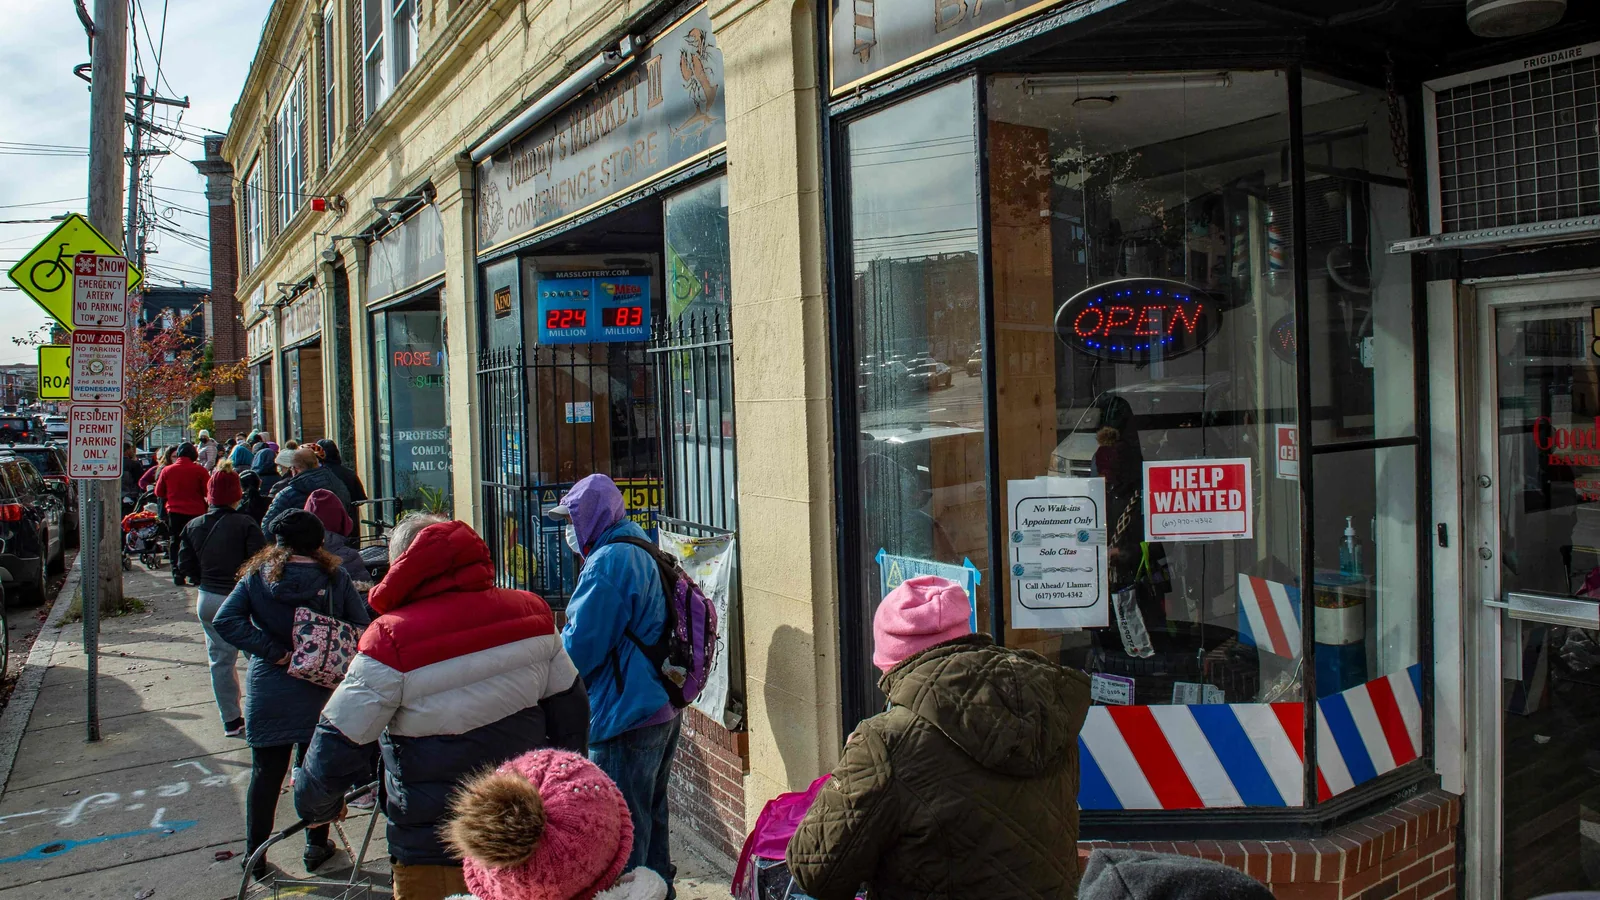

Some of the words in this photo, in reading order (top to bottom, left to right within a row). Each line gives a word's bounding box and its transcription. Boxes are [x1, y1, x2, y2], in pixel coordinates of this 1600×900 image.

[1523, 47, 1582, 69] FRIGIDAIRE
[569, 70, 641, 155] MARKET
[508, 165, 596, 232] CONVENIENCE
[600, 131, 658, 188] STORE
[98, 261, 125, 272] SNOW
[556, 270, 630, 278] MASSLOTTERY.COM
[79, 279, 122, 289] EMERGENCY
[86, 291, 114, 300] ARTERY
[77, 302, 87, 311] NO
[91, 302, 123, 312] PARKING
[547, 309, 587, 328] 224
[616, 307, 643, 326] 83
[1074, 304, 1202, 337] OPEN
[549, 329, 587, 337] MILLION
[605, 327, 643, 335] MILLION
[75, 333, 95, 342] TOW
[99, 334, 122, 343] ZONE
[394, 351, 431, 367] ROSE
[74, 411, 119, 421] RESIDENT
[79, 424, 113, 433] PERMIT
[75, 437, 117, 446] PARKING
[83, 449, 108, 459] ONLY
[412, 461, 435, 471] NAIL
[1171, 467, 1224, 490] HELP
[1154, 489, 1242, 513] WANTED
[1033, 505, 1045, 513] No
[1022, 518, 1072, 527] Appointment
[1074, 516, 1093, 526] Only
[1039, 548, 1056, 556] Solo
[1058, 548, 1077, 556] Citas
[1035, 592, 1052, 600] (617)
[1053, 591, 1083, 599] 970-4342
